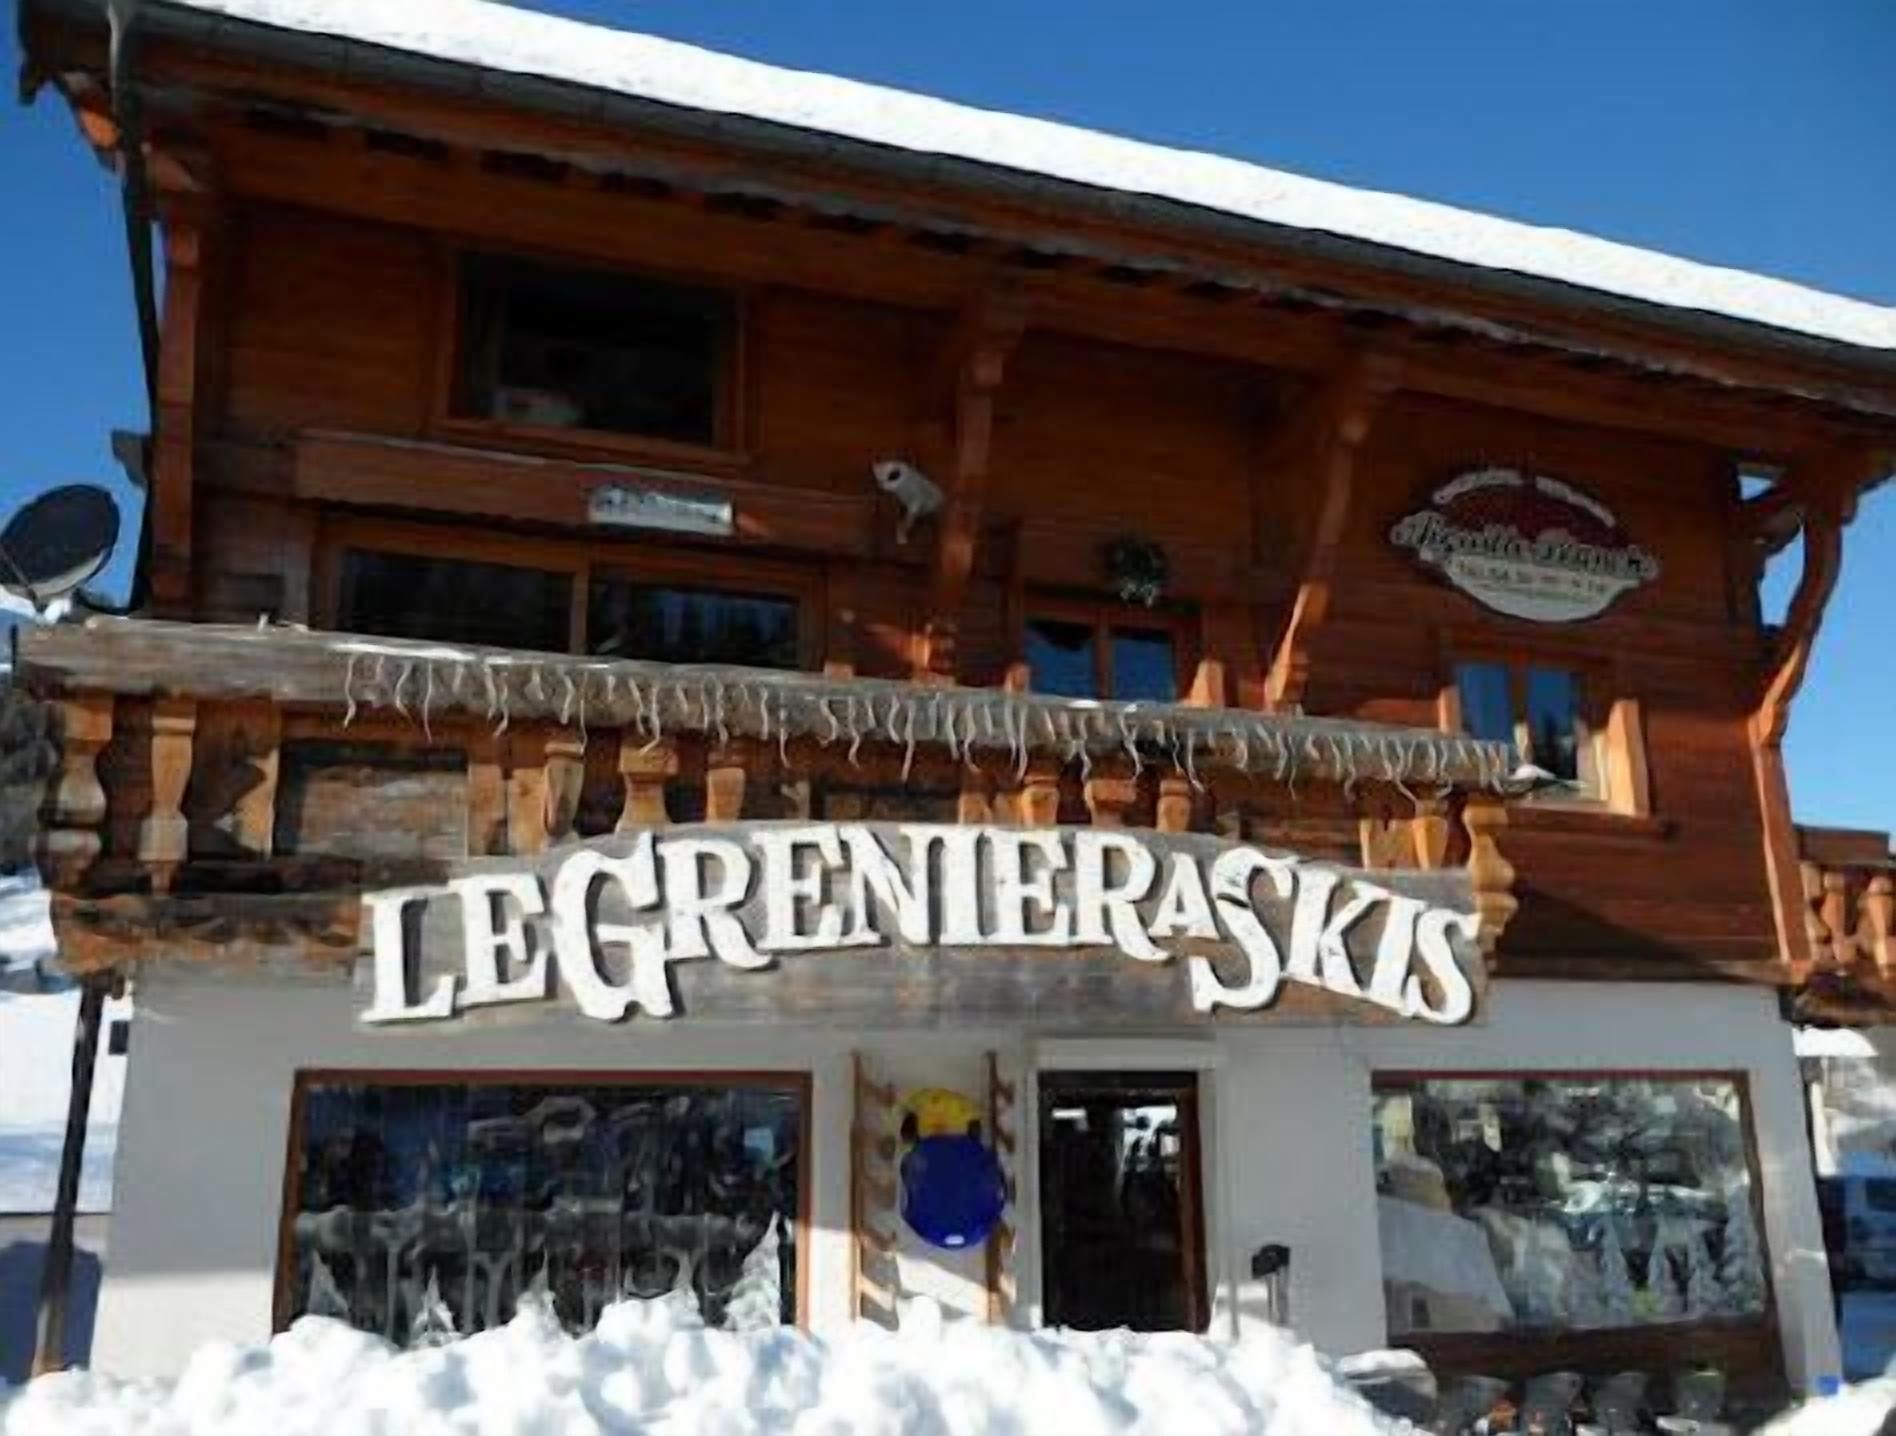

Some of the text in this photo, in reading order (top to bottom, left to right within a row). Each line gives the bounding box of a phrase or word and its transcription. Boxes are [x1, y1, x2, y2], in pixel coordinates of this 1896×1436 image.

[361, 823, 1481, 1026] LE GRENIER A SKIS
